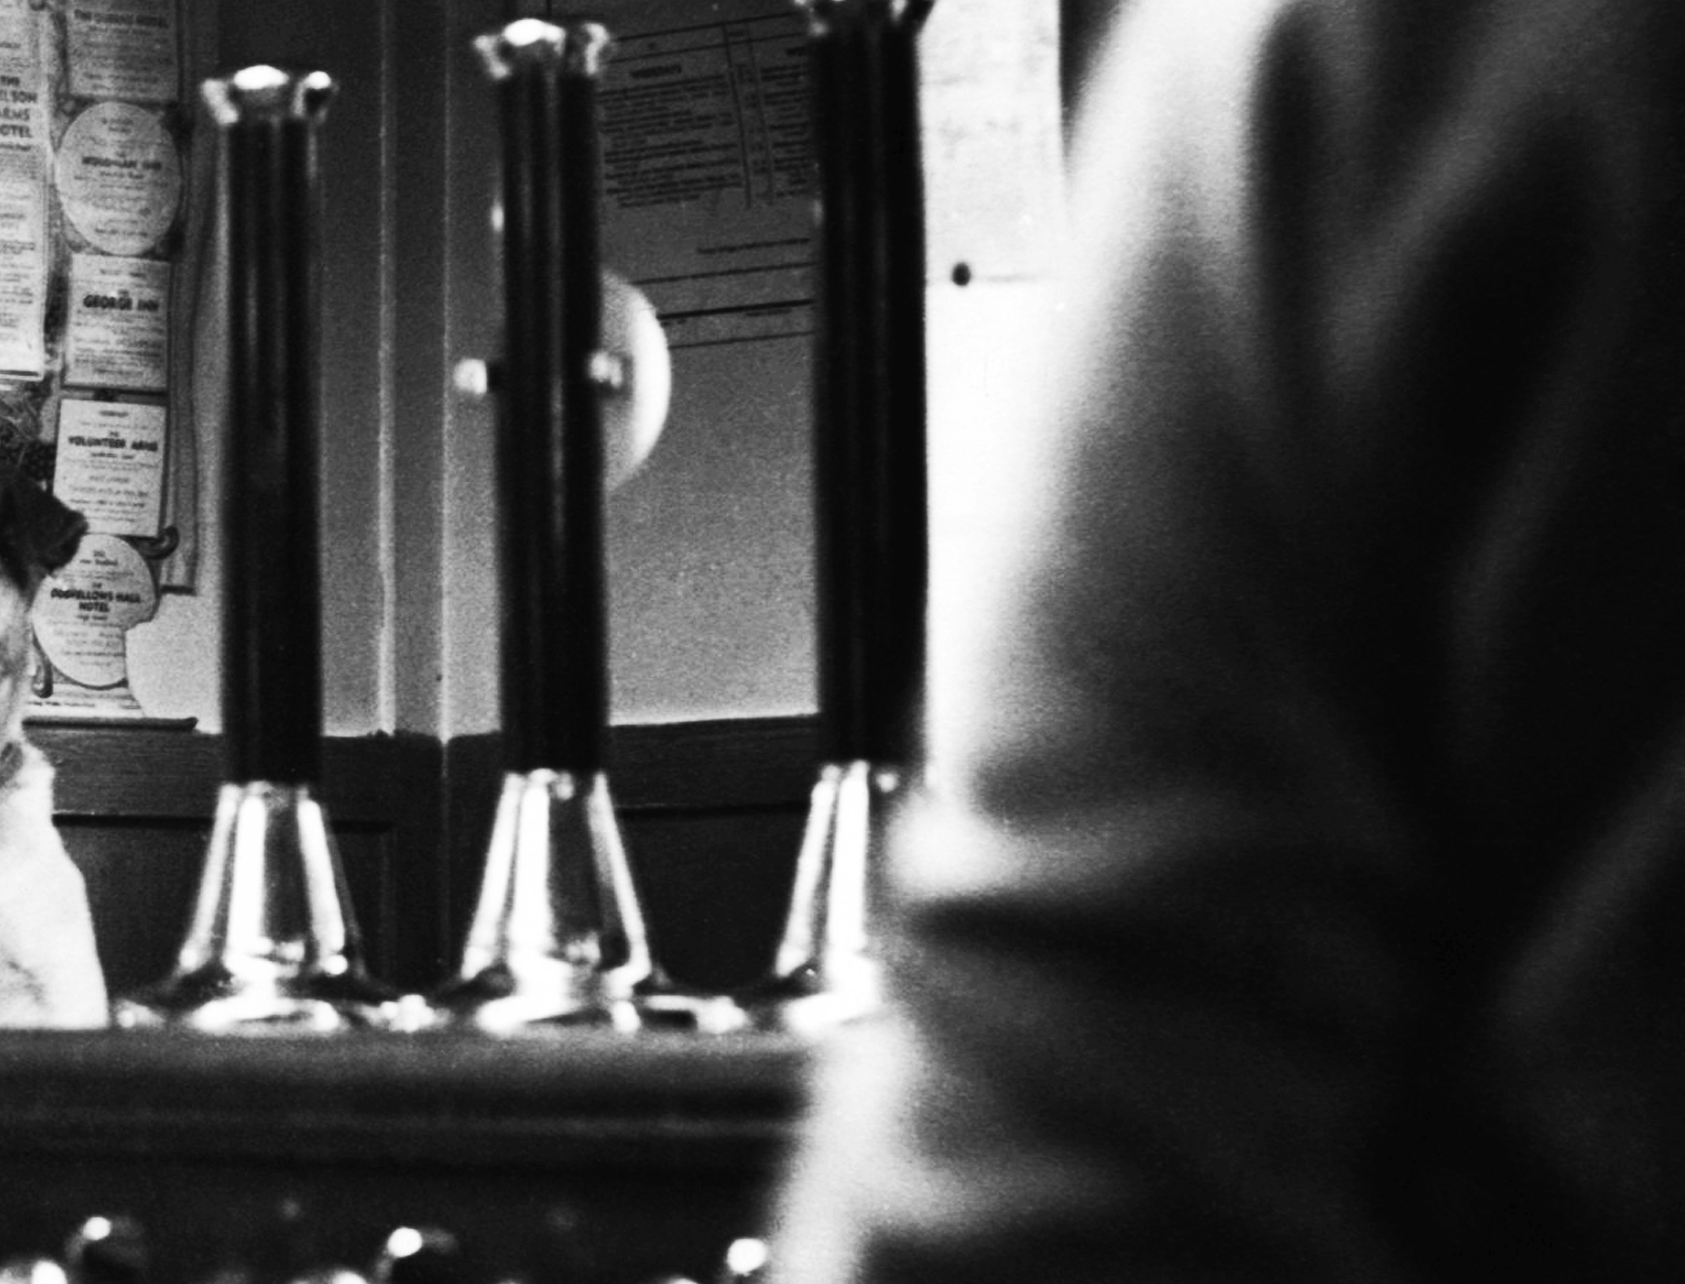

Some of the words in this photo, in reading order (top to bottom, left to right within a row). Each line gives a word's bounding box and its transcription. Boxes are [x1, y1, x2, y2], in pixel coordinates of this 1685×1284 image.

[82, 293, 134, 311] GEORGE
[67, 435, 127, 450] VOLUNTEER
[77, 601, 111, 614] HOTEL
